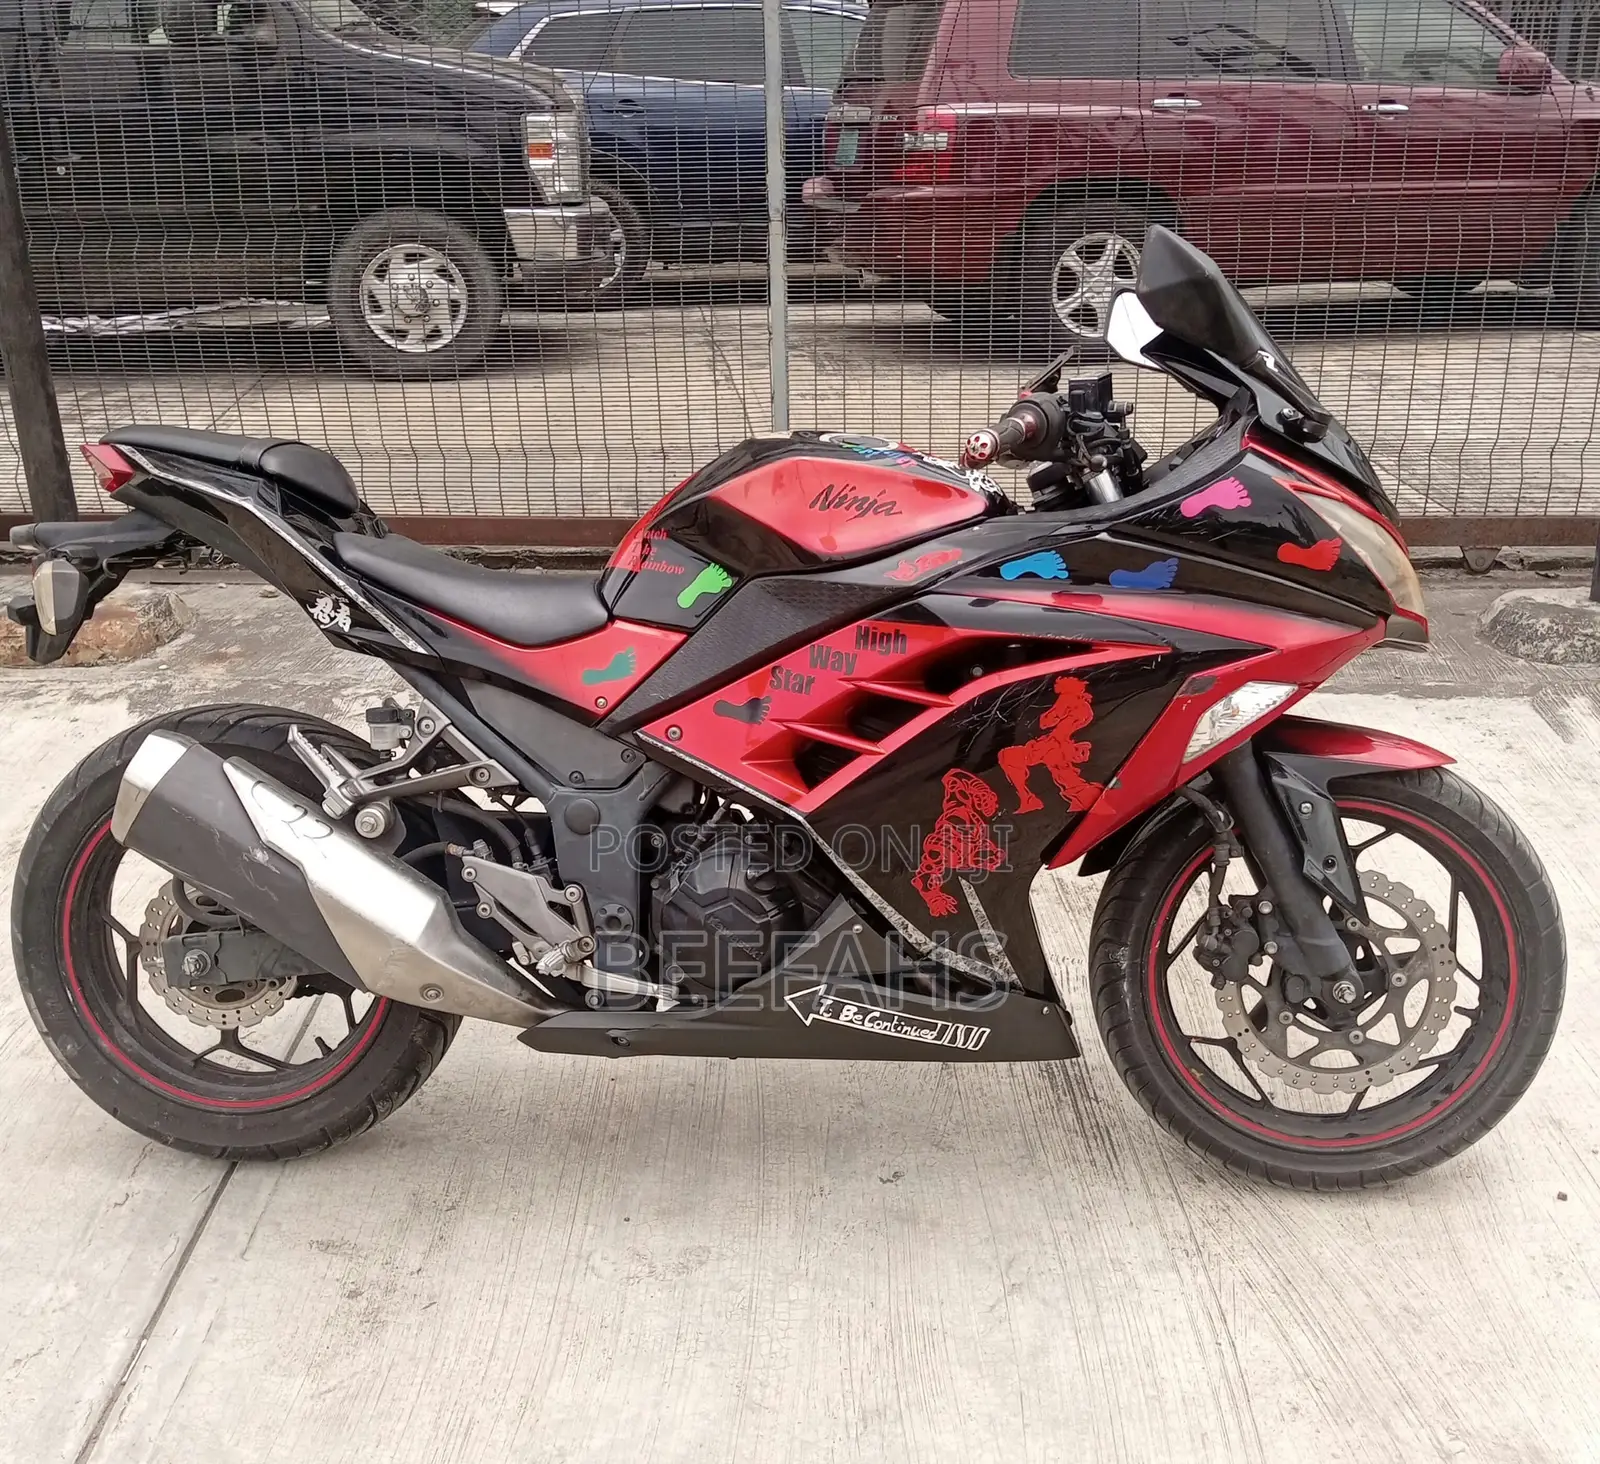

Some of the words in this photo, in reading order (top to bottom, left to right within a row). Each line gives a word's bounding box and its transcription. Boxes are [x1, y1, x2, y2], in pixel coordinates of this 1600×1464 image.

[808, 483, 903, 522] Ninja
[854, 624, 907, 656] High
[808, 644, 858, 676] Way
[769, 665, 816, 696] Star
